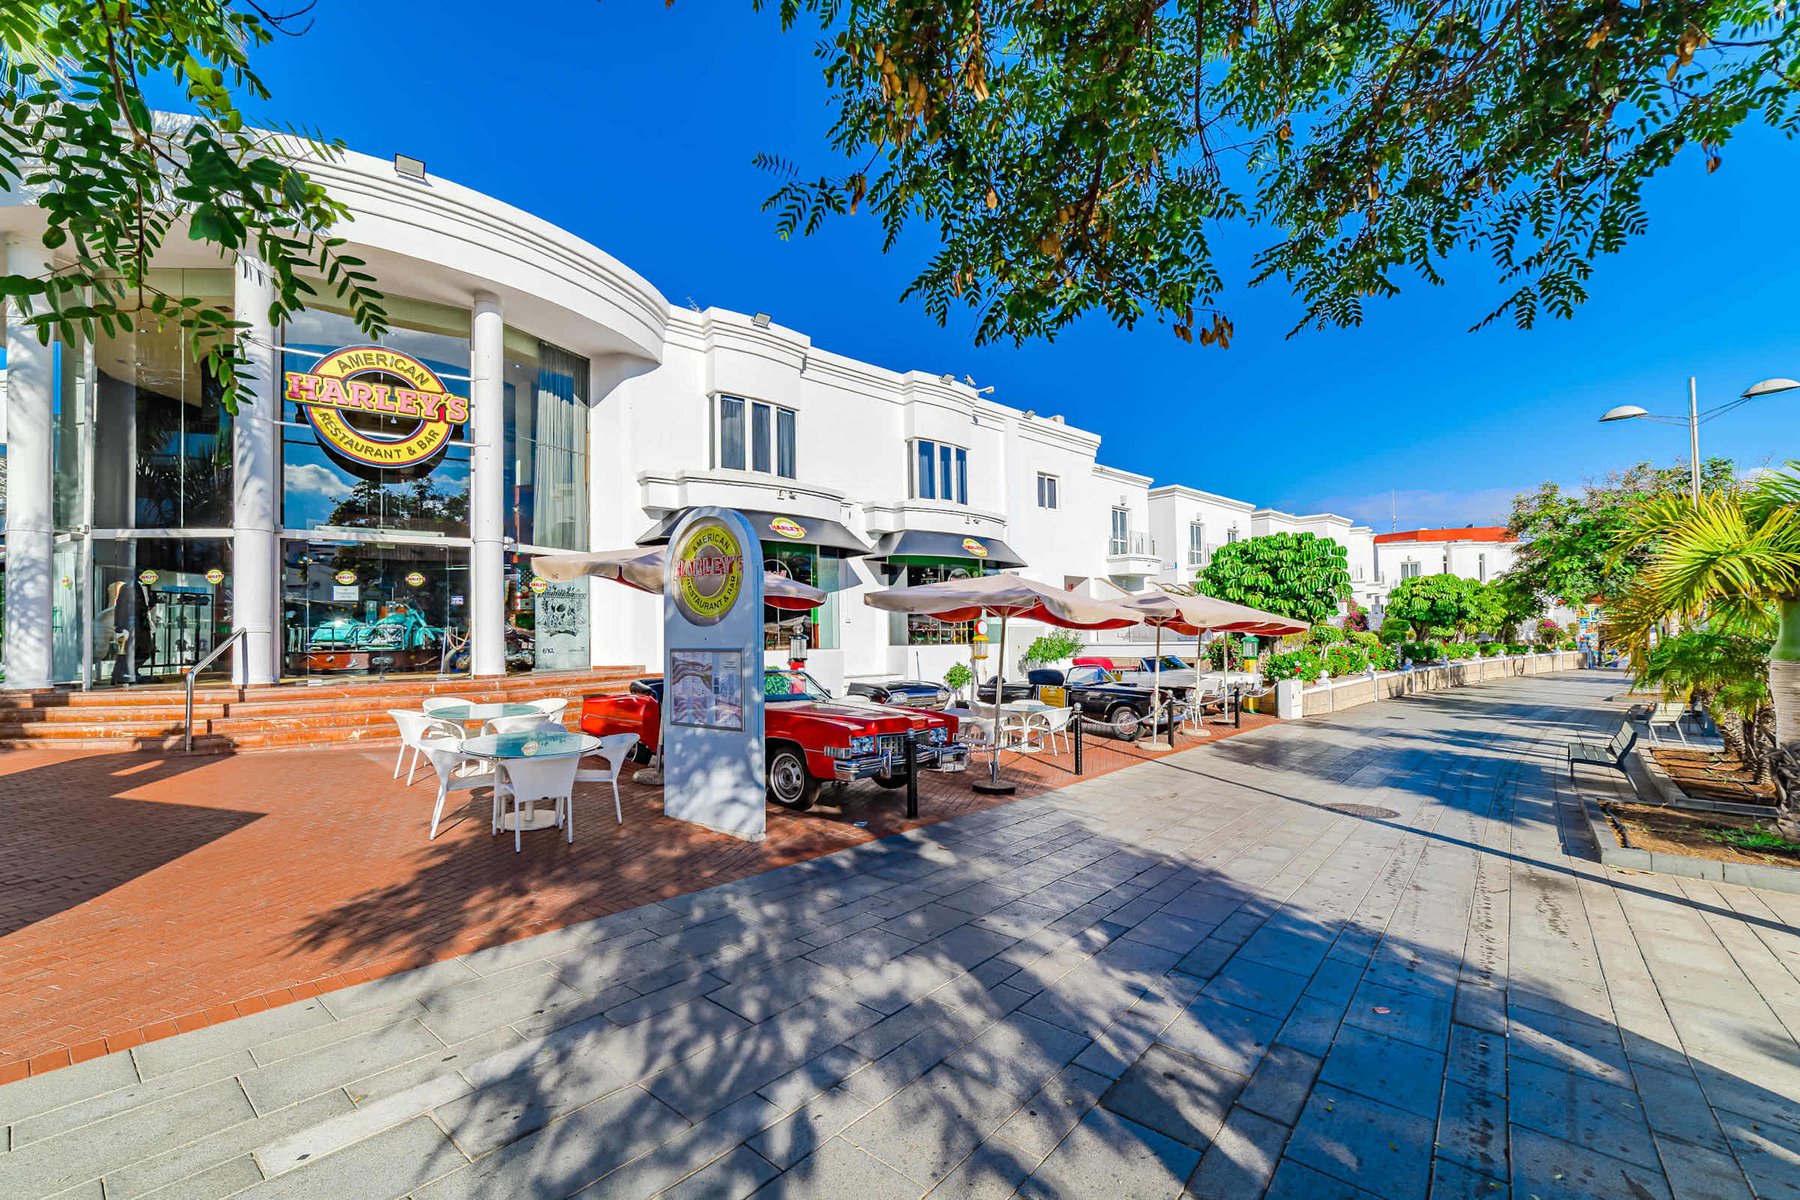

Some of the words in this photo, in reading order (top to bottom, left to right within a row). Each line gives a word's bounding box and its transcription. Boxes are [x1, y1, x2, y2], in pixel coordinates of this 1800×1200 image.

[336, 352, 431, 387] AMERICAN
[287, 373, 468, 423] HARLEY'S
[319, 412, 401, 460] RESTAURANT
[408, 446, 416, 456] &
[416, 429, 440, 451] BAR
[693, 534, 730, 552] AMERICAN
